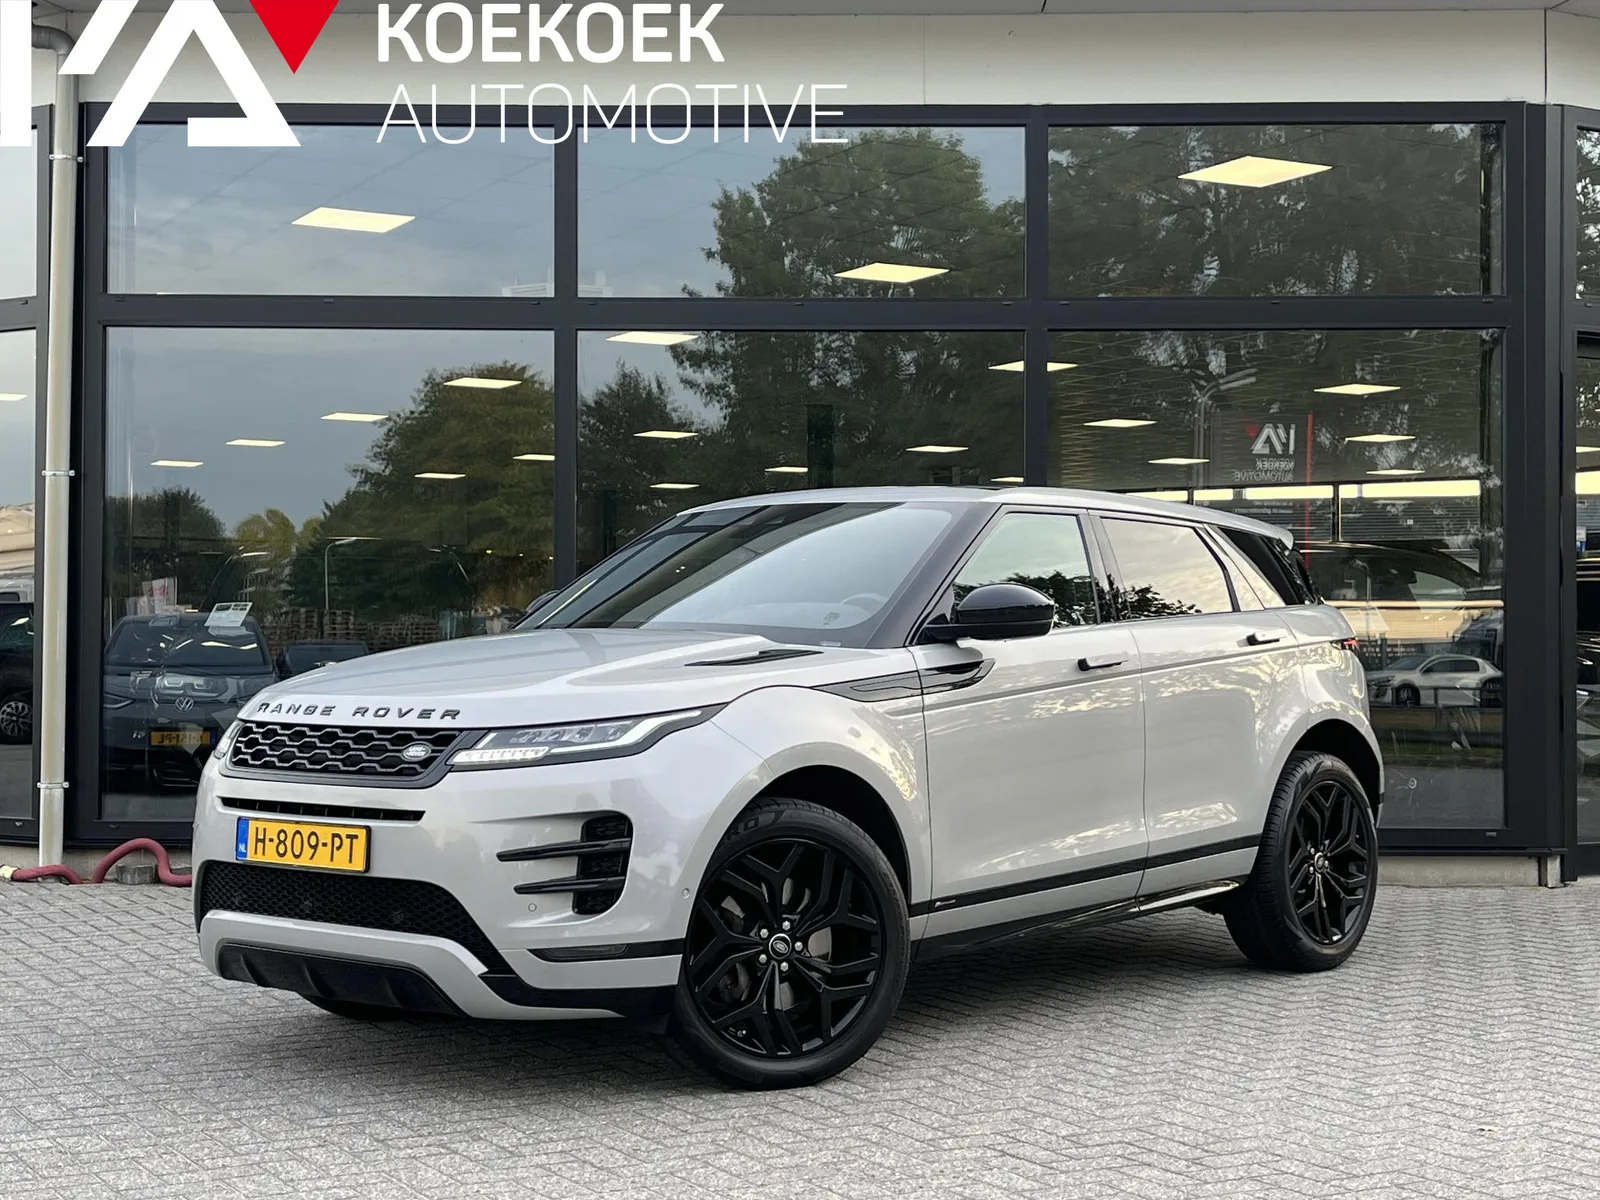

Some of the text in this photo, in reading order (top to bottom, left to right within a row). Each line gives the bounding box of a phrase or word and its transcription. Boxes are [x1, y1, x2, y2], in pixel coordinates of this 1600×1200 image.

[256, 702, 461, 721] RANGE ROVER
[254, 826, 359, 864] H-809-PT
